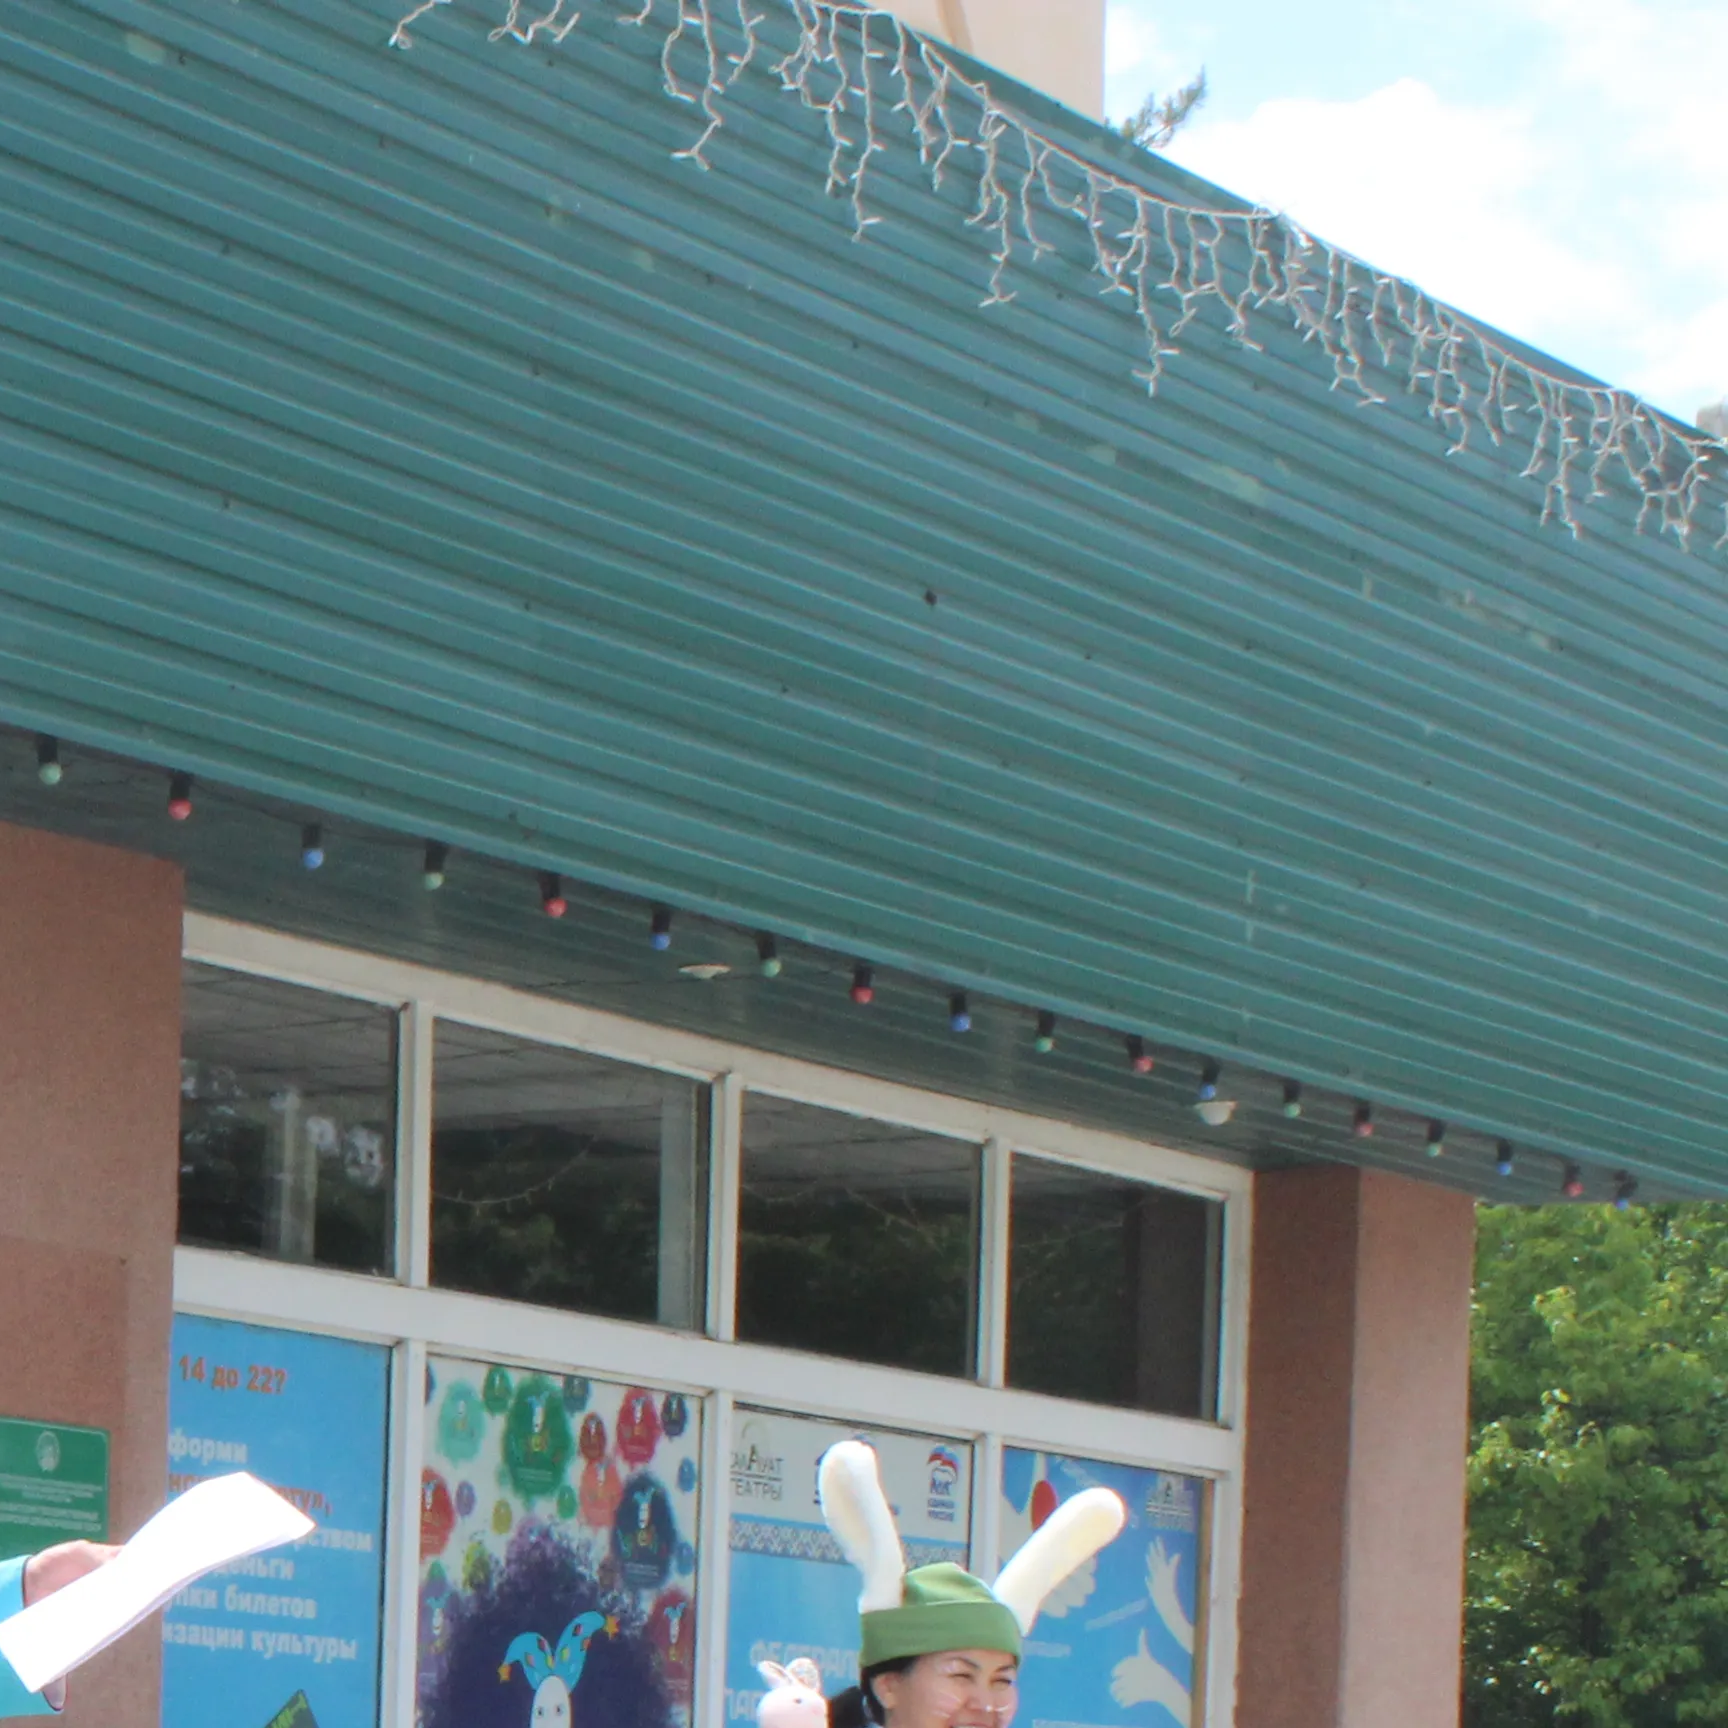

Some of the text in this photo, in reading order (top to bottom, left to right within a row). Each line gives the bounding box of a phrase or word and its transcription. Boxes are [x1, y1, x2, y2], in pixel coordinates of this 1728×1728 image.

[179, 1355, 287, 1394] 14 до 22?
[224, 1583, 317, 1619] билетов
[251, 1629, 358, 1664] культуры
